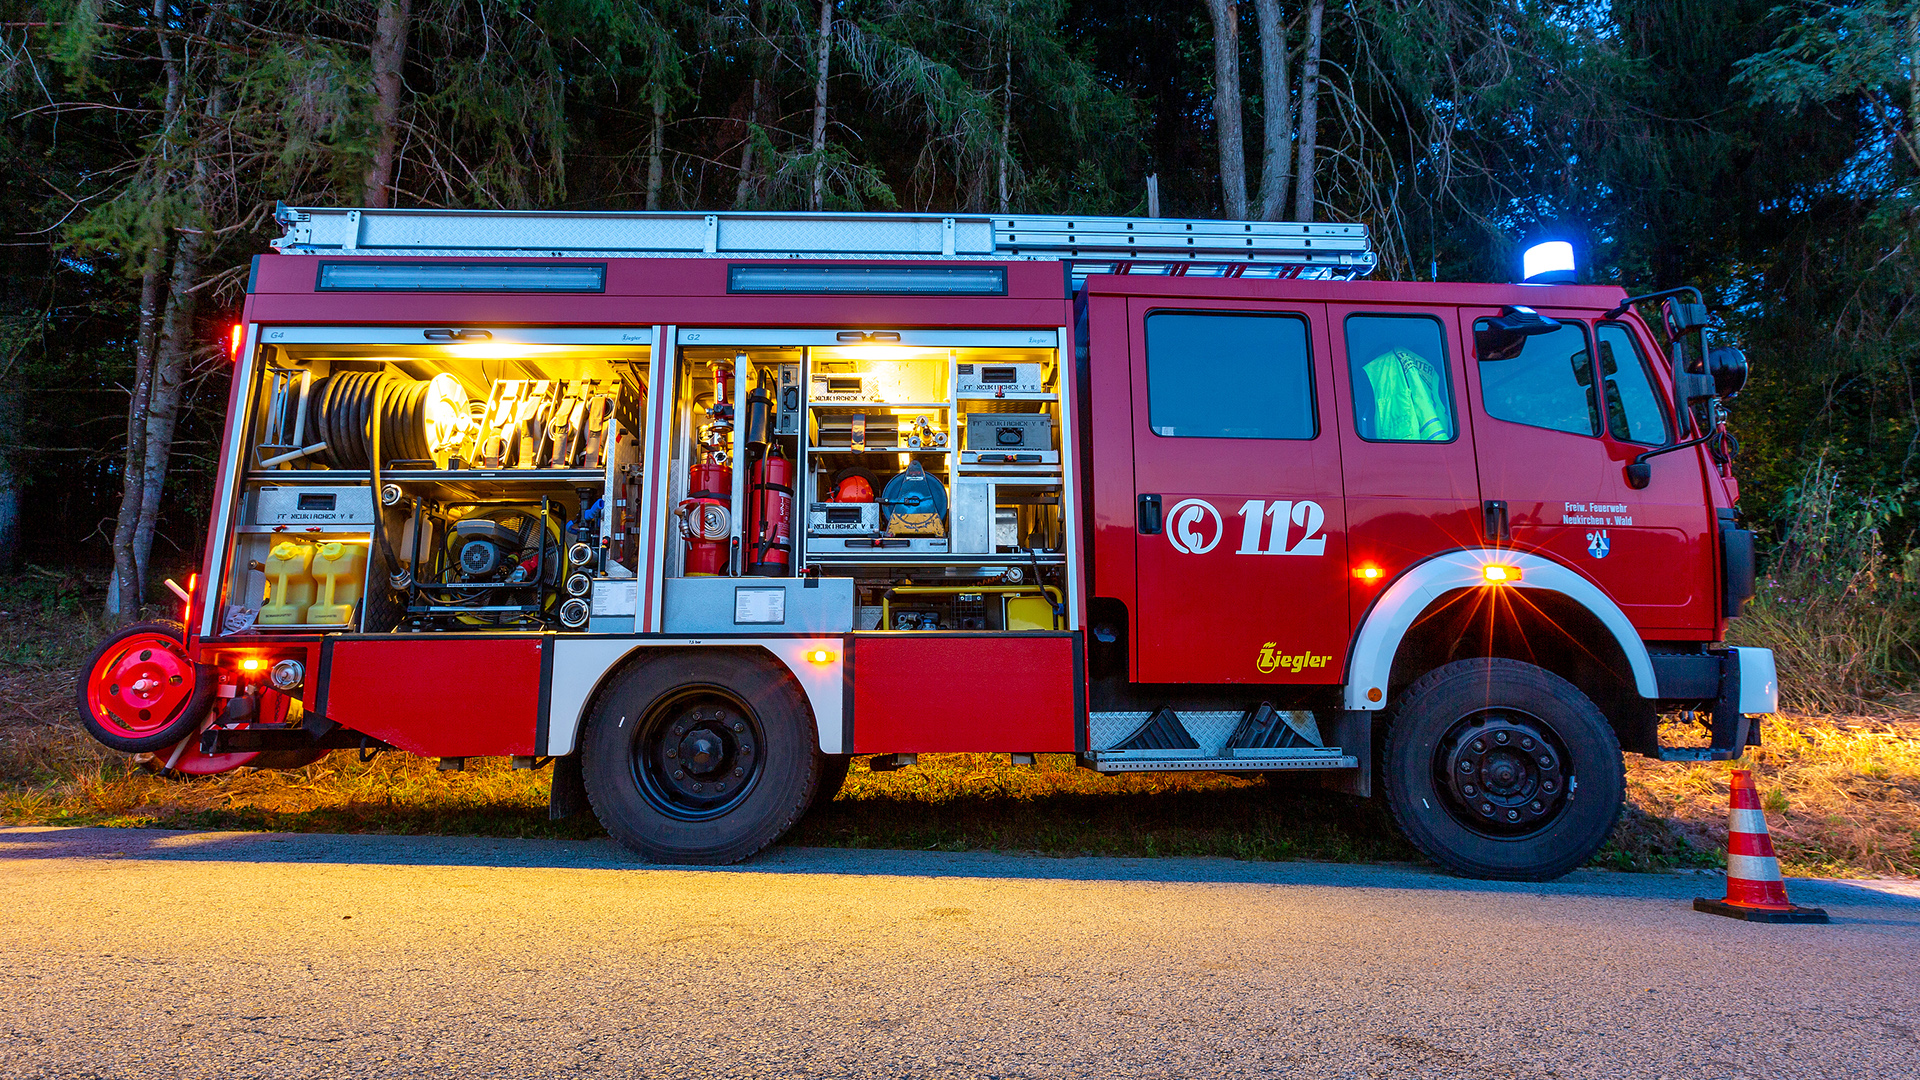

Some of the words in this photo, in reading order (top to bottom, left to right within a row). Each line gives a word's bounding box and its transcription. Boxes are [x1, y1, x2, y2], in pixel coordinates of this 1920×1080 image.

[270, 331, 285, 339] G4
[687, 333, 701, 341] G2
[1565, 502, 1588, 512] Freiw.
[1589, 502, 1628, 513] Feuerwehr
[1562, 514, 1605, 525] Neukirchen
[1606, 517, 1613, 525] v.
[1614, 516, 1633, 526] Wald
[1236, 500, 1327, 556] 112
[1257, 643, 1333, 674] Ziegler
